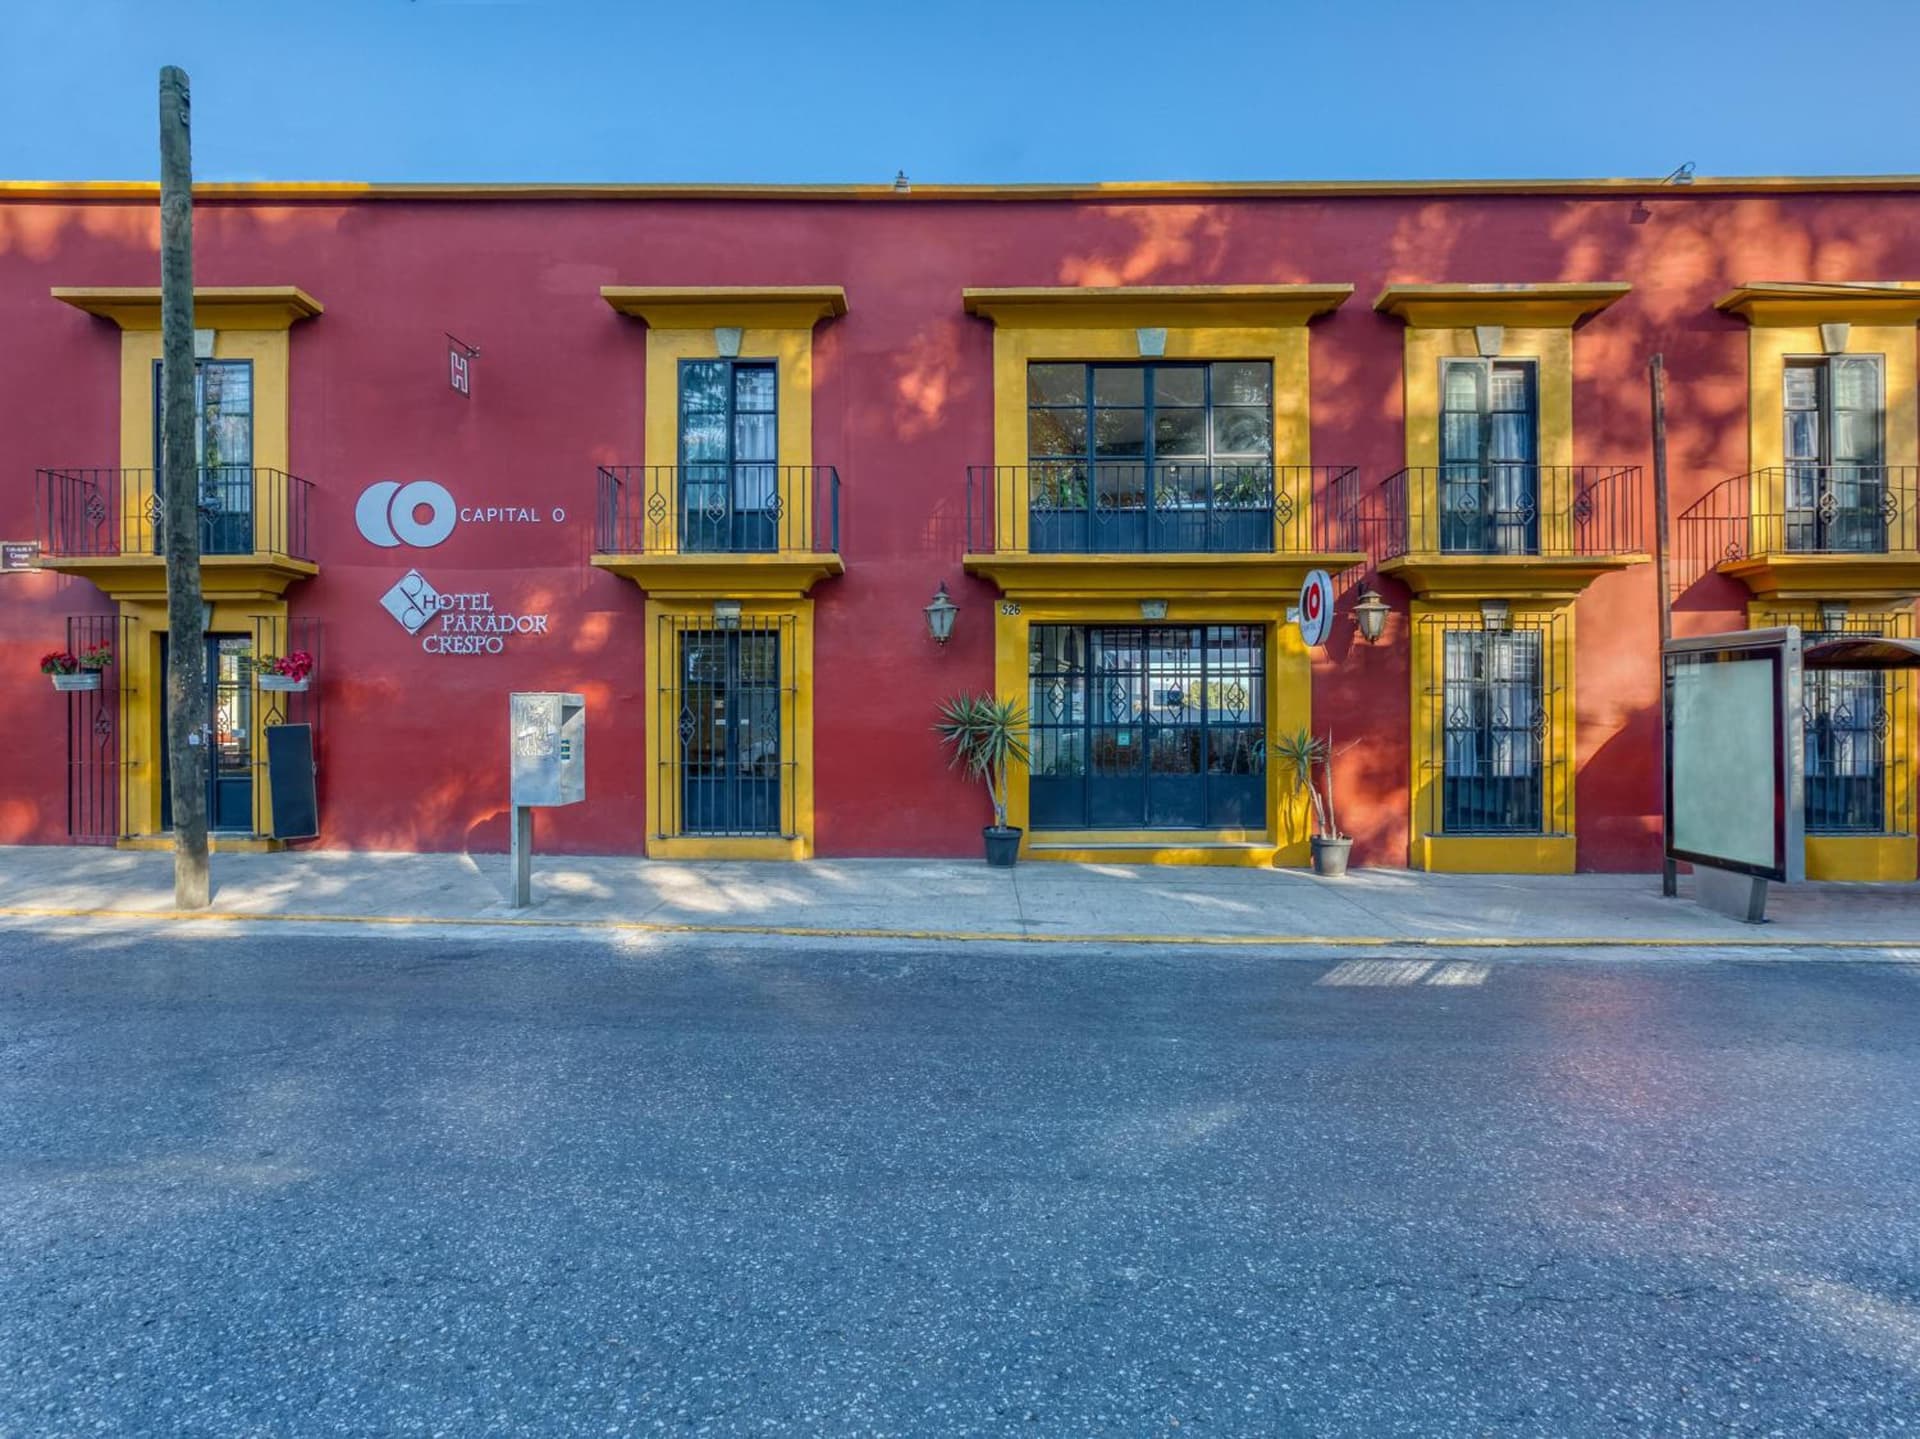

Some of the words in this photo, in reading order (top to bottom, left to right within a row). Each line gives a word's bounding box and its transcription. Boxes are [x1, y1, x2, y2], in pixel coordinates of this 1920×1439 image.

[460, 508, 541, 522] CAPITAL
[552, 508, 565, 522] O
[423, 592, 493, 611] HOTEL
[1002, 604, 1021, 615] 526
[441, 614, 548, 633] PARADOR
[422, 635, 504, 653] CRESPO
